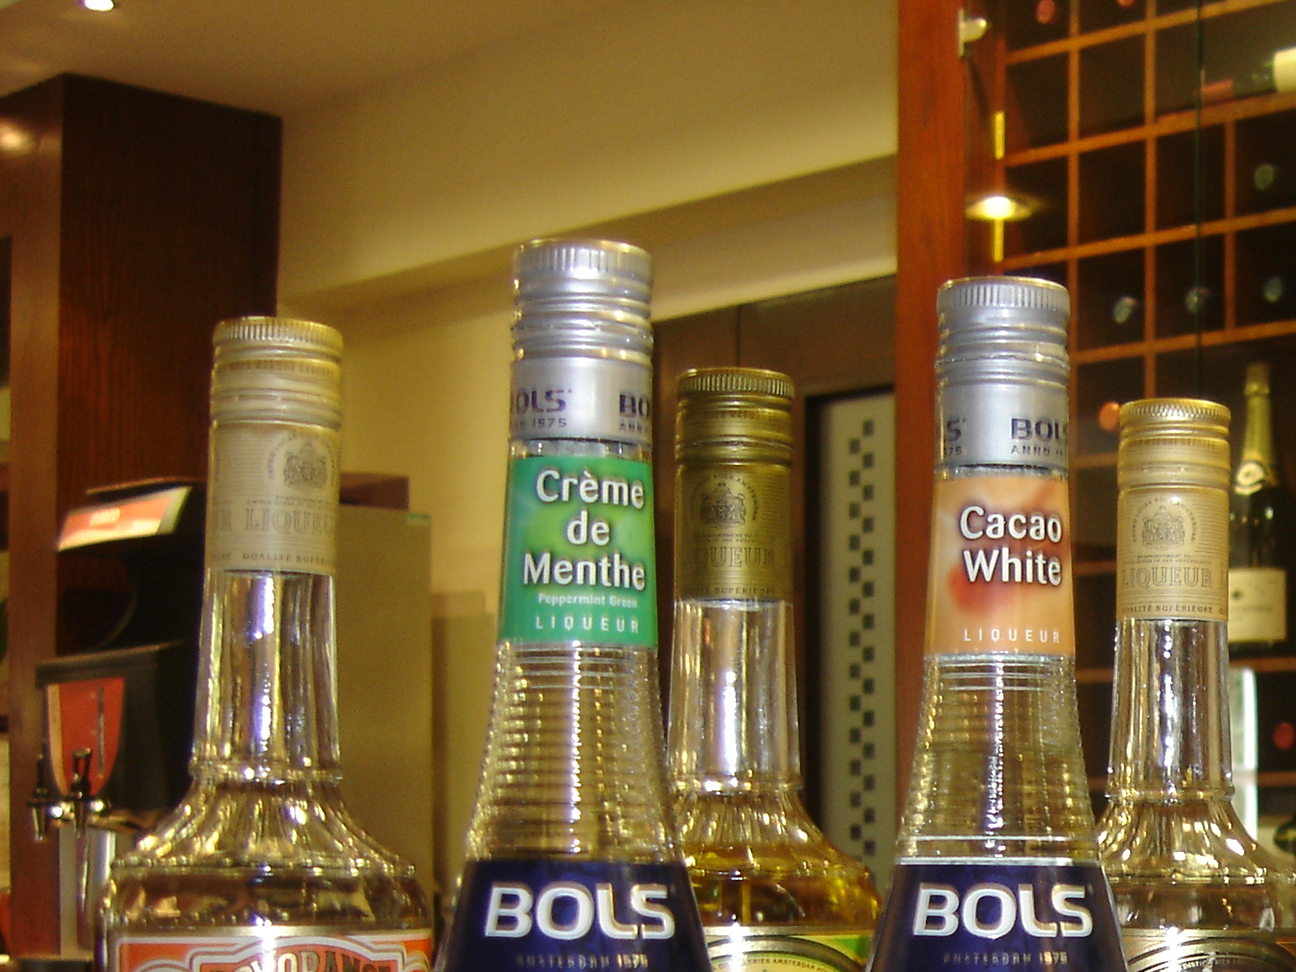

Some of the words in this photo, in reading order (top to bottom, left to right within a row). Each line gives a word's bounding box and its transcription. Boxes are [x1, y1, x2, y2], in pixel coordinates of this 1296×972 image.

[536, 469, 644, 509] Crème
[566, 509, 610, 545] de
[960, 506, 1062, 543] Cacao
[523, 552, 646, 591] Menthe
[963, 547, 1062, 586] White
[538, 593, 607, 607] Peppermint
[535, 616, 638, 634] LIQUEUR
[964, 628, 1060, 644] LIQUEUR
[485, 881, 676, 941] BOLS
[913, 883, 1093, 939] BOLS
